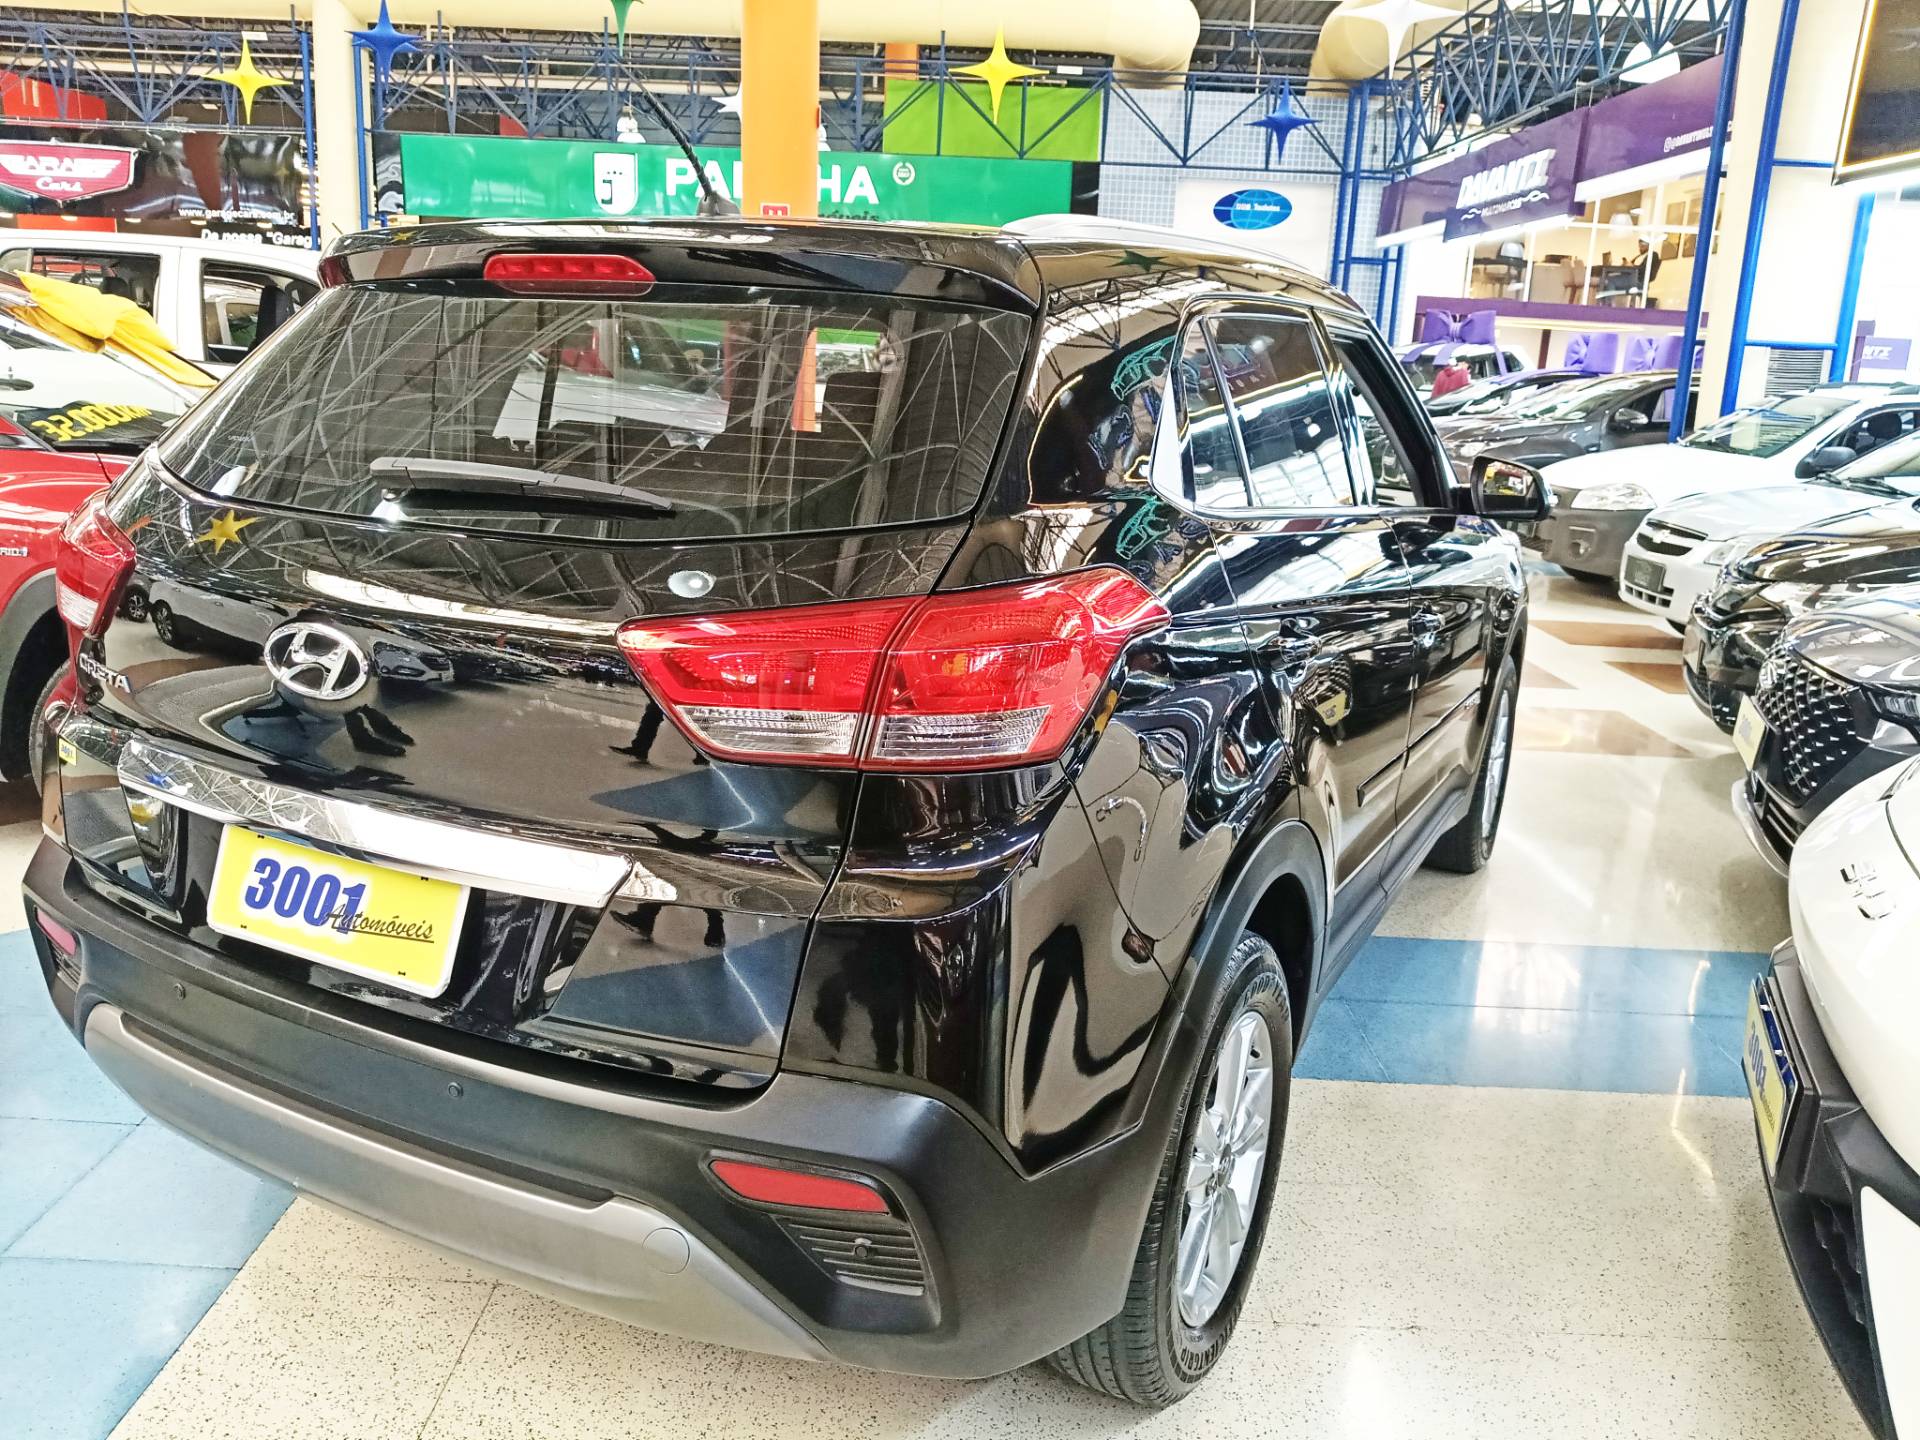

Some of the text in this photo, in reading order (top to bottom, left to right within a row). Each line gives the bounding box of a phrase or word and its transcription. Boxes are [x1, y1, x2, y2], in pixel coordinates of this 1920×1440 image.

[1456, 148, 1557, 209] DAVANTI
[79, 653, 131, 694] CRETA
[244, 857, 366, 934] 3001
[323, 903, 434, 940] Automóveis
